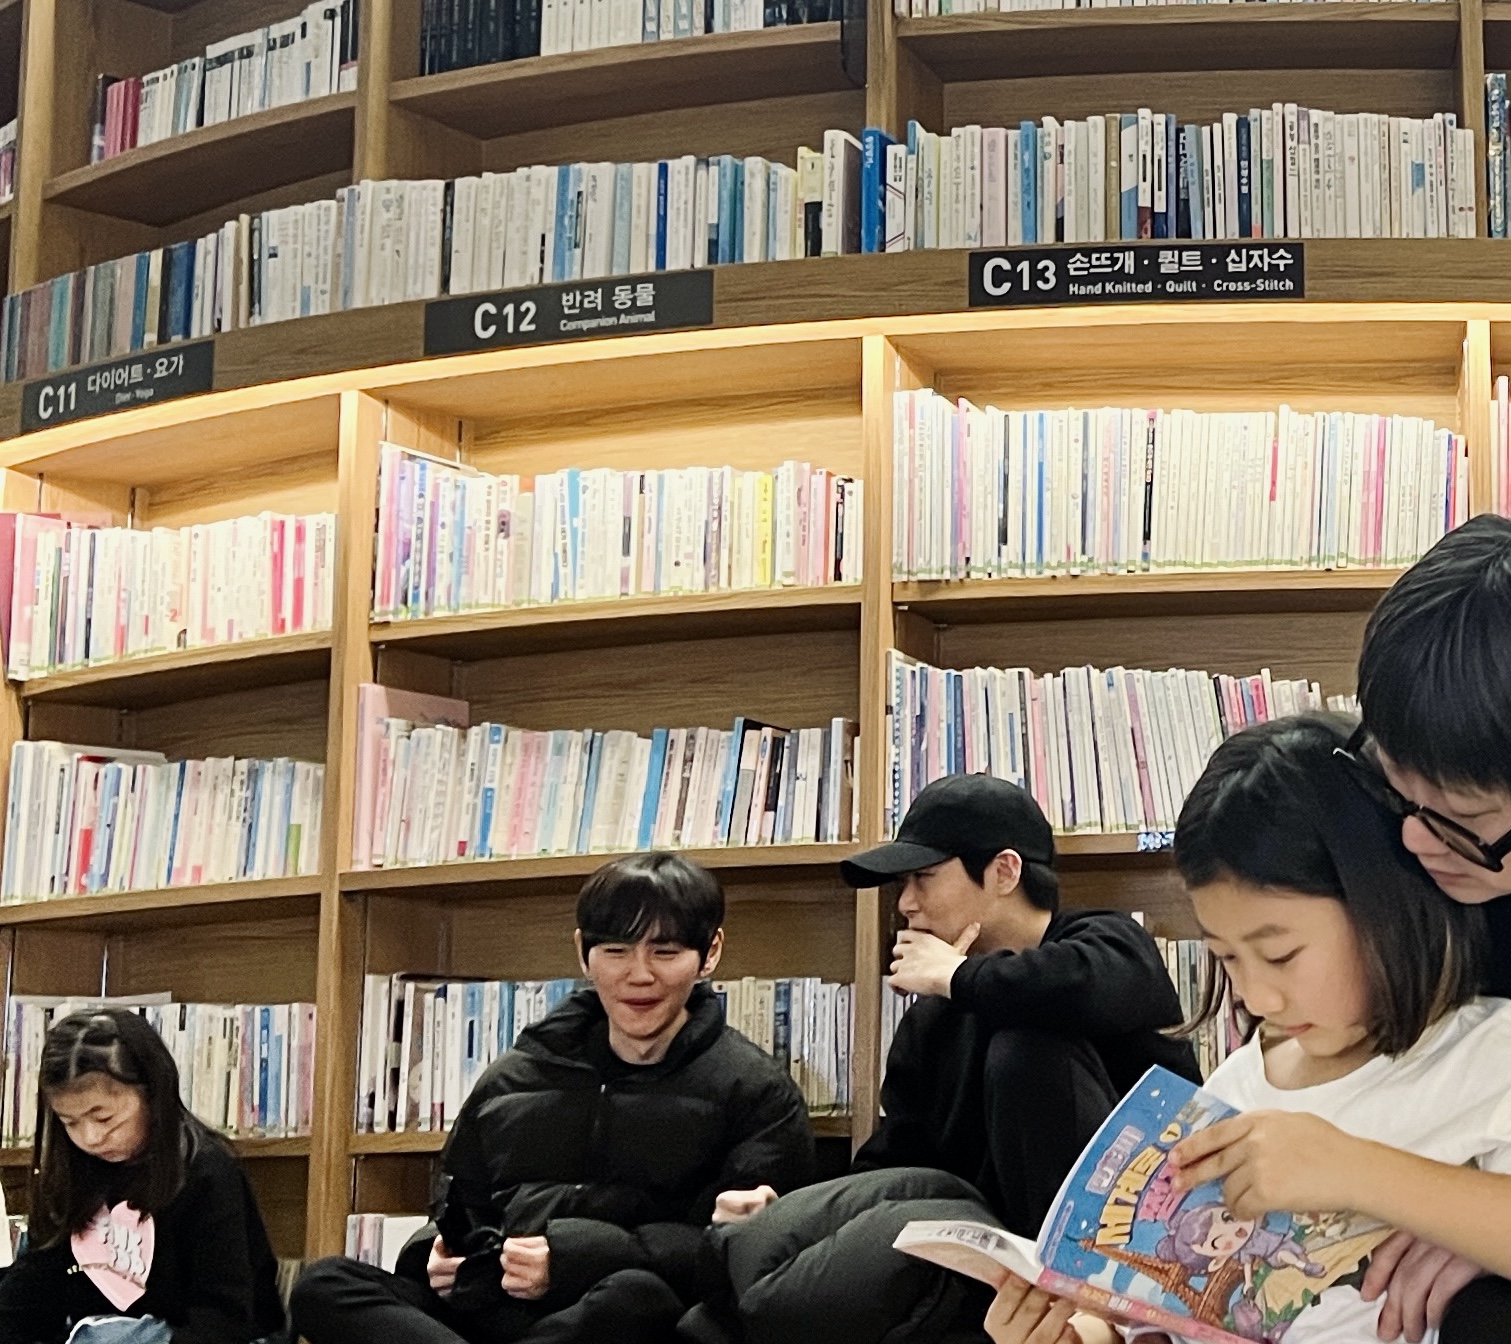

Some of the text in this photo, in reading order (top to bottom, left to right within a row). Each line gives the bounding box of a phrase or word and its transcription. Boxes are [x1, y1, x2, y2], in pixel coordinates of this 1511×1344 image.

[982, 257, 1057, 297] C13
[1067, 248, 1294, 276] 손뜨개 퀼트 십자수
[561, 283, 656, 315] 반려 동물
[1068, 278, 1294, 295] Hand Knitted Quilt Cross-Stitch
[473, 300, 537, 340] C12
[560, 310, 656, 332] Companion Animal
[38, 381, 77, 420] C11
